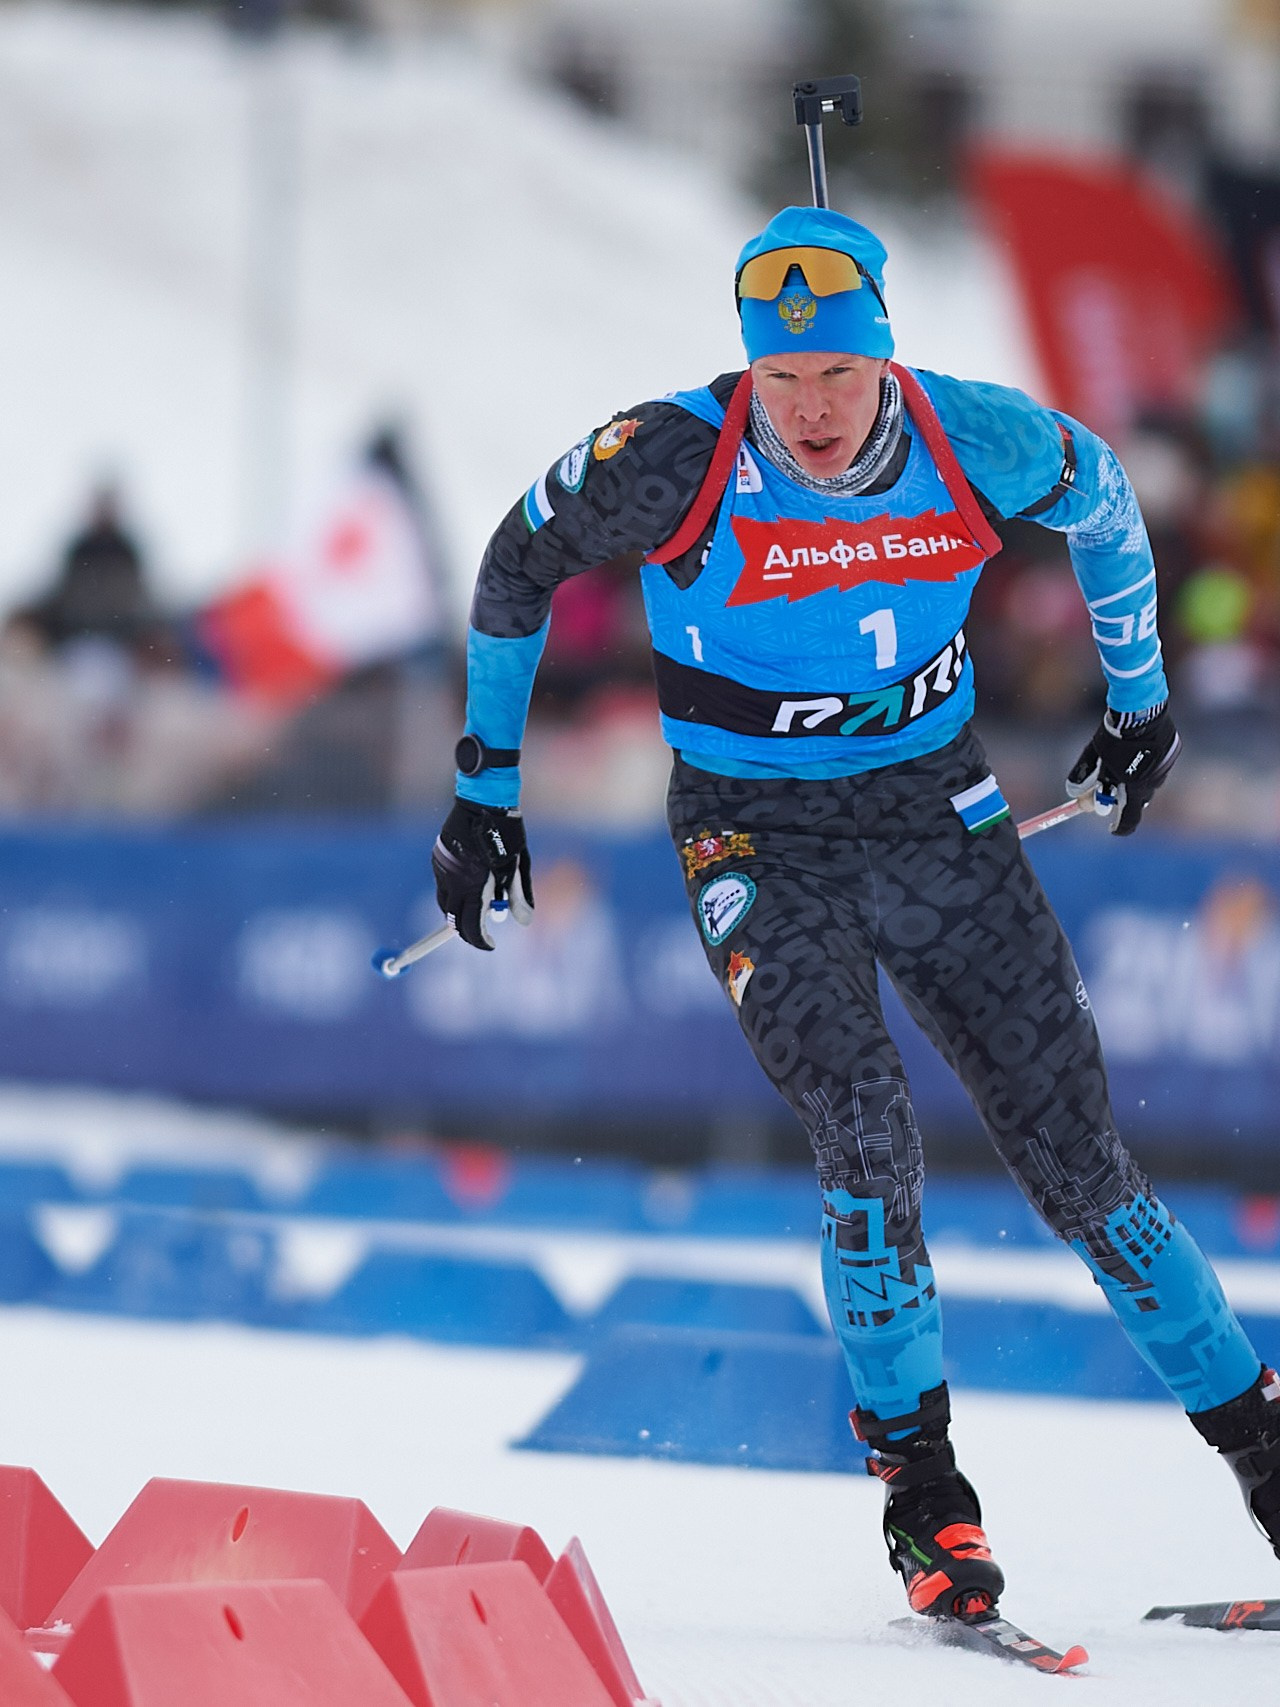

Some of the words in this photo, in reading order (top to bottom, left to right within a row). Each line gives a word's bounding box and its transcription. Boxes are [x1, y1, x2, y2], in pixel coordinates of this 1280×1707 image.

[763, 539, 878, 569] Альфа
[685, 625, 704, 663] 1
[858, 608, 898, 670] 1
